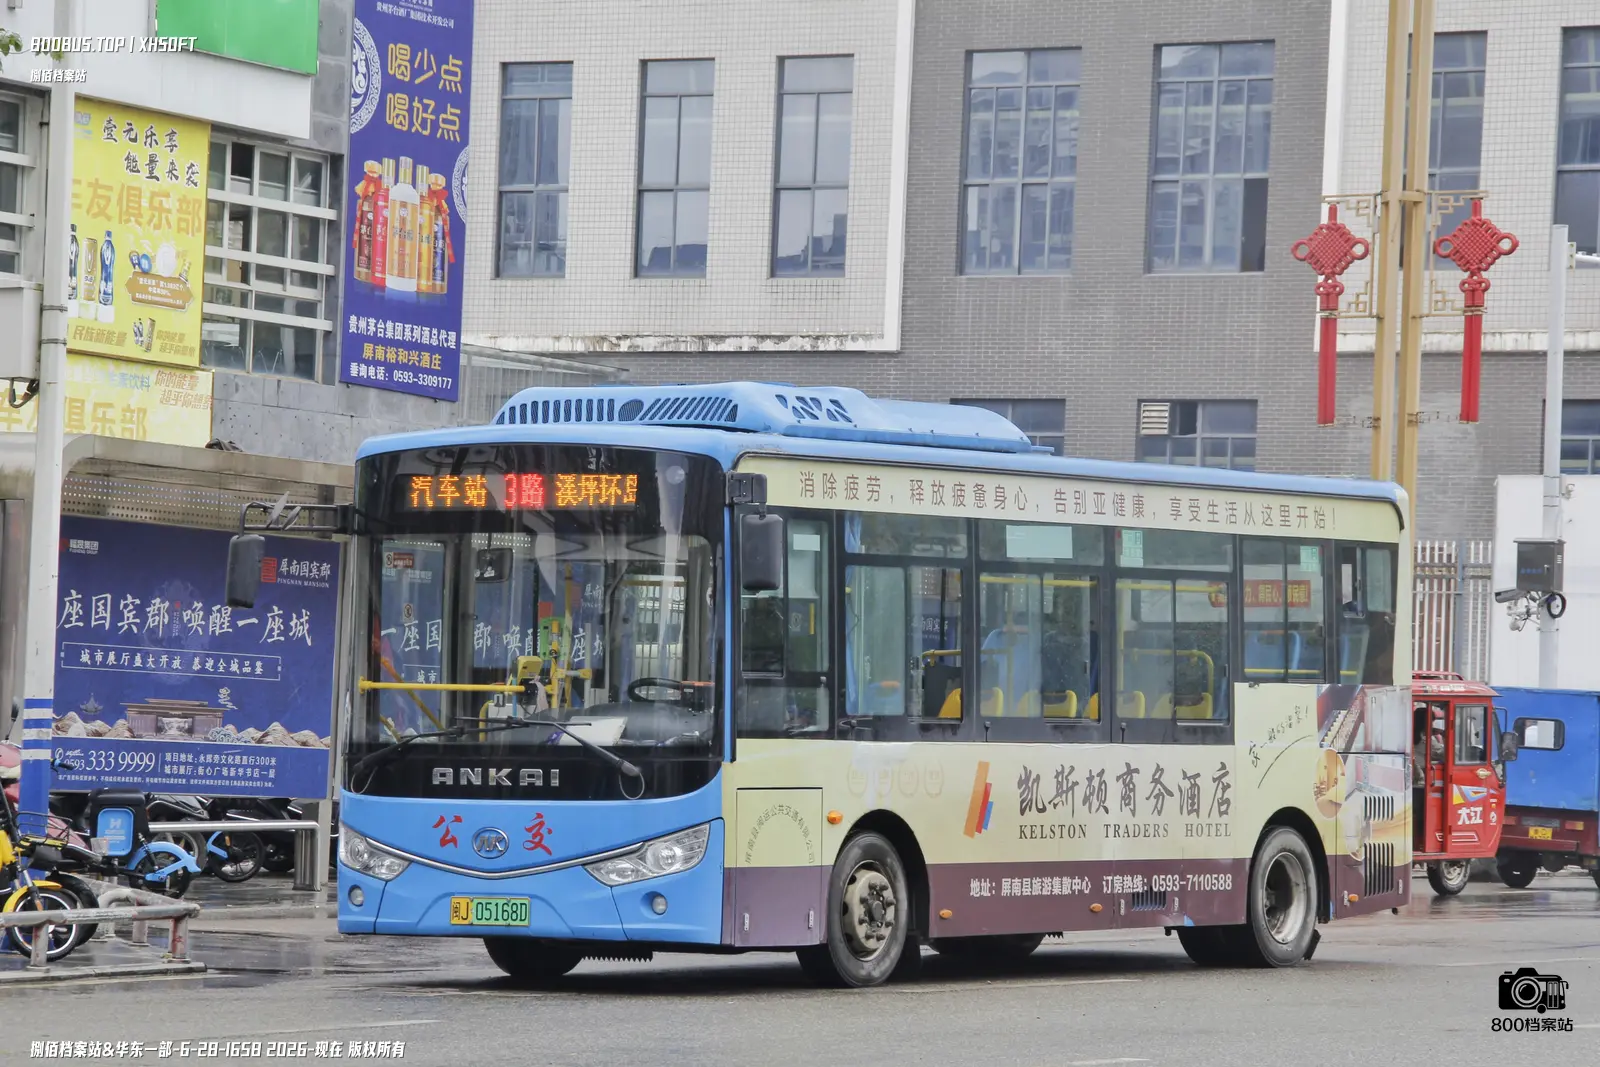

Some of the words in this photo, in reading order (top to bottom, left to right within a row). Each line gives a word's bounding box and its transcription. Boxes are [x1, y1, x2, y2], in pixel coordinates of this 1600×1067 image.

[387, 43, 463, 94] 喝少点
[386, 93, 461, 143] 喝好点
[103, 116, 179, 153] 壹元乐享
[124, 151, 199, 187] 能量来袭
[348, 314, 457, 349] 贵州茅台集团系列酒总代理
[362, 342, 442, 370] 屏南裕和兴酒庄
[155, 369, 200, 392] 你的能量
[411, 474, 487, 507] 汽车站
[276, 577, 303, 586] PINGNAN
[303, 580, 330, 589] MANSION
[279, 558, 331, 581] 屏南国宾郡
[79, 648, 182, 670] 城市展厅盛大开放
[191, 655, 264, 675] 恭迎全城品鉴
[86, 750, 115, 771] 333
[117, 751, 155, 773] 9999
[431, 766, 560, 787] ANKAI
[1016, 761, 1233, 819] 凯斯顿商务酒店
[1457, 806, 1483, 825] 大江
[1018, 823, 1087, 840] KELSTON
[1103, 822, 1169, 839] TRADERS
[1184, 822, 1232, 838] HOTEL
